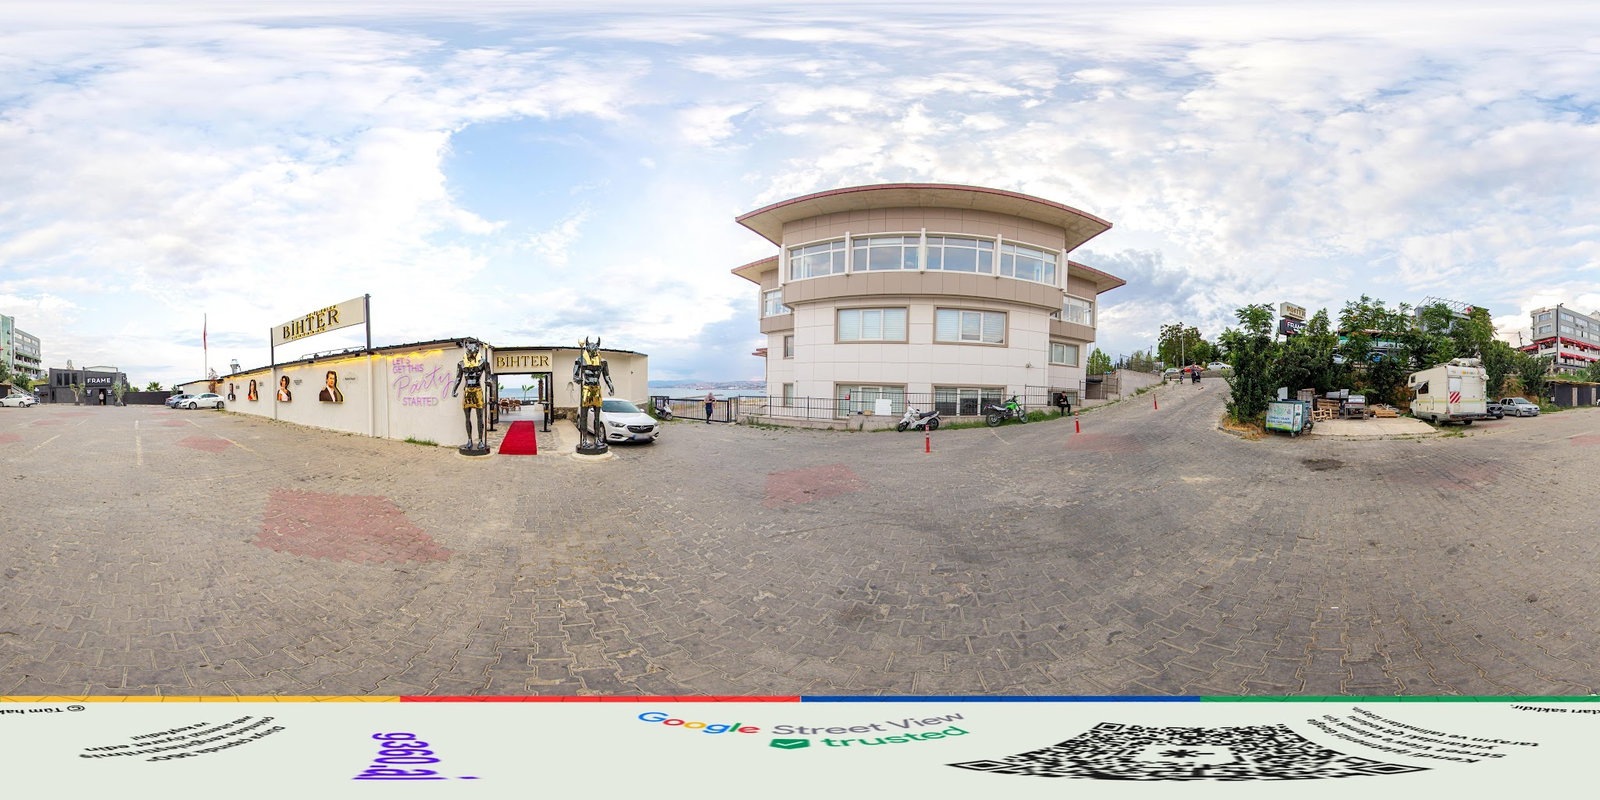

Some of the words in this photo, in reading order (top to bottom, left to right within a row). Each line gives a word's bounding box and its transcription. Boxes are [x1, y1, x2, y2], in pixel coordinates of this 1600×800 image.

[283, 308, 339, 339] BİHTER
[496, 353, 549, 368] BİHTER
[393, 364, 405, 374] GET
[407, 363, 424, 373] THIS
[393, 366, 454, 399] Party
[402, 396, 439, 407] STARTED
